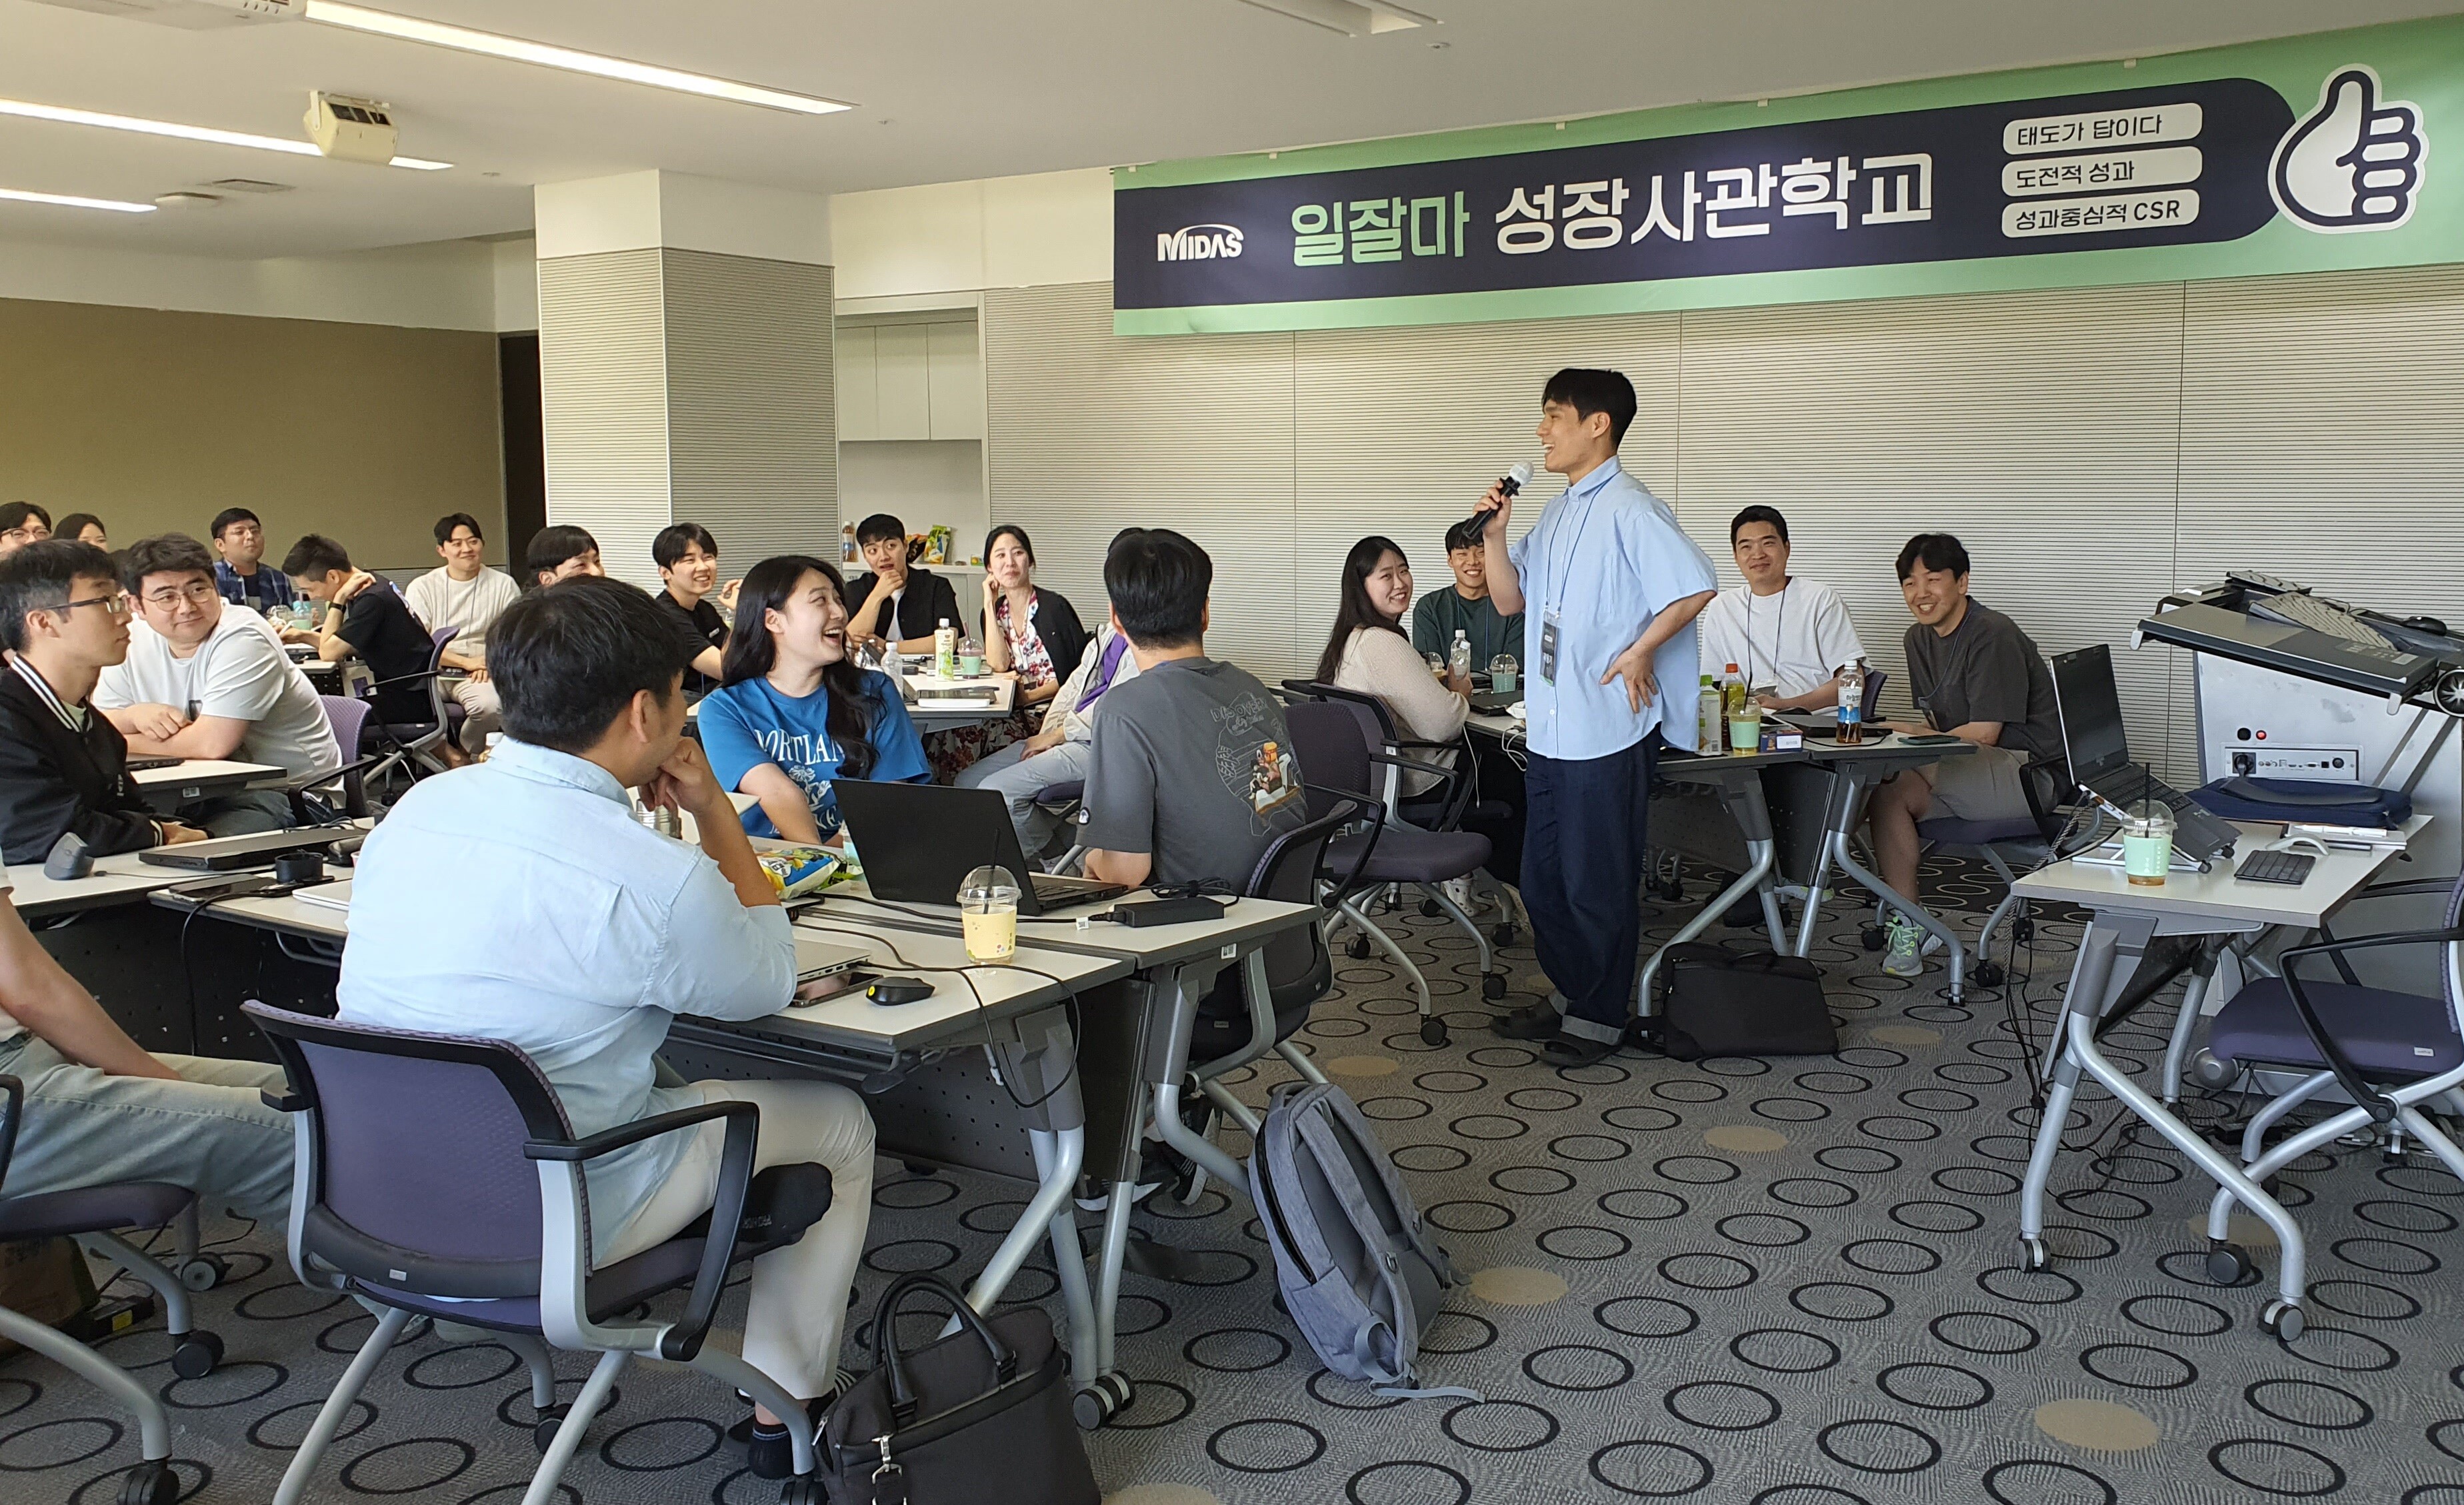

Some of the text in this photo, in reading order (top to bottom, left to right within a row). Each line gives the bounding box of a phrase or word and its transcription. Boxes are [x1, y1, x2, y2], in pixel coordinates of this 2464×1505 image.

[2017, 114, 2162, 146] 태도가 답이다
[2017, 161, 2135, 189] 도전적 성과
[1291, 153, 1933, 267] 일잘마 성장사관학교
[2016, 200, 2180, 231] 성과중심적 CSR
[1157, 224, 1244, 262] MIDAS
